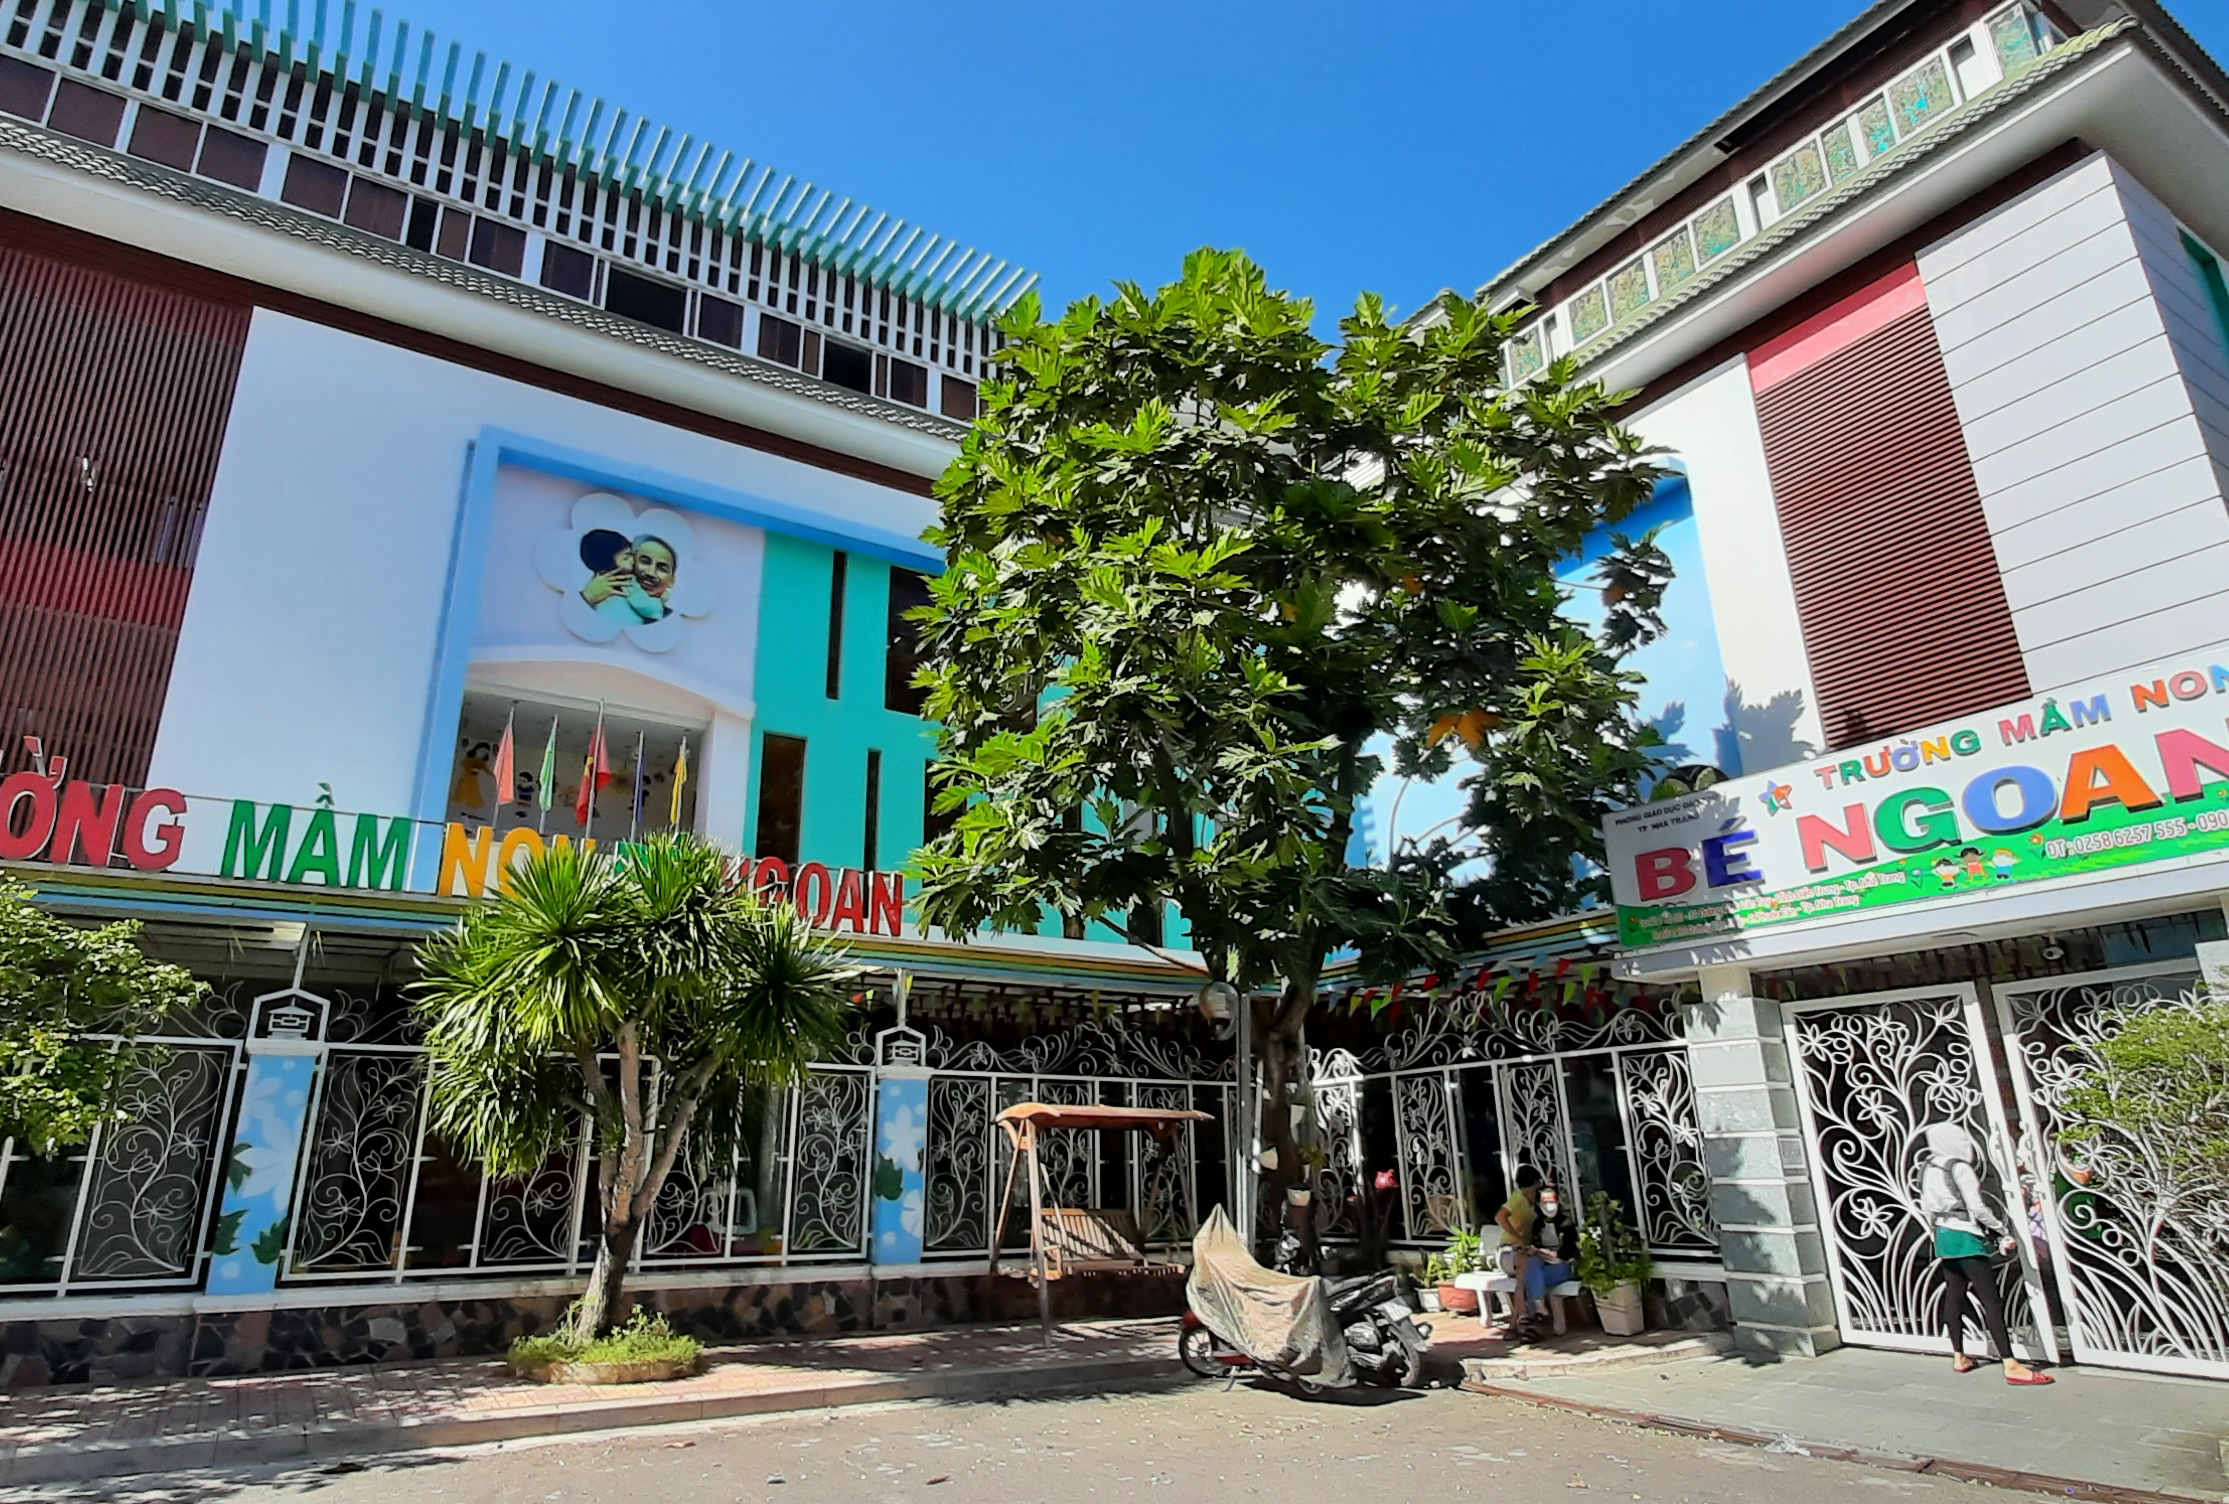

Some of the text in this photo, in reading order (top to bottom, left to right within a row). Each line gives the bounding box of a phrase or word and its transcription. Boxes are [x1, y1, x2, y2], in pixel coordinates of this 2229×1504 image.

[1814, 729, 1981, 789] TRƯỜNG
[1997, 697, 2112, 747] MẦM
[220, 782, 411, 892] MẦM
[1635, 718, 2229, 901] BÉ NGOAN
